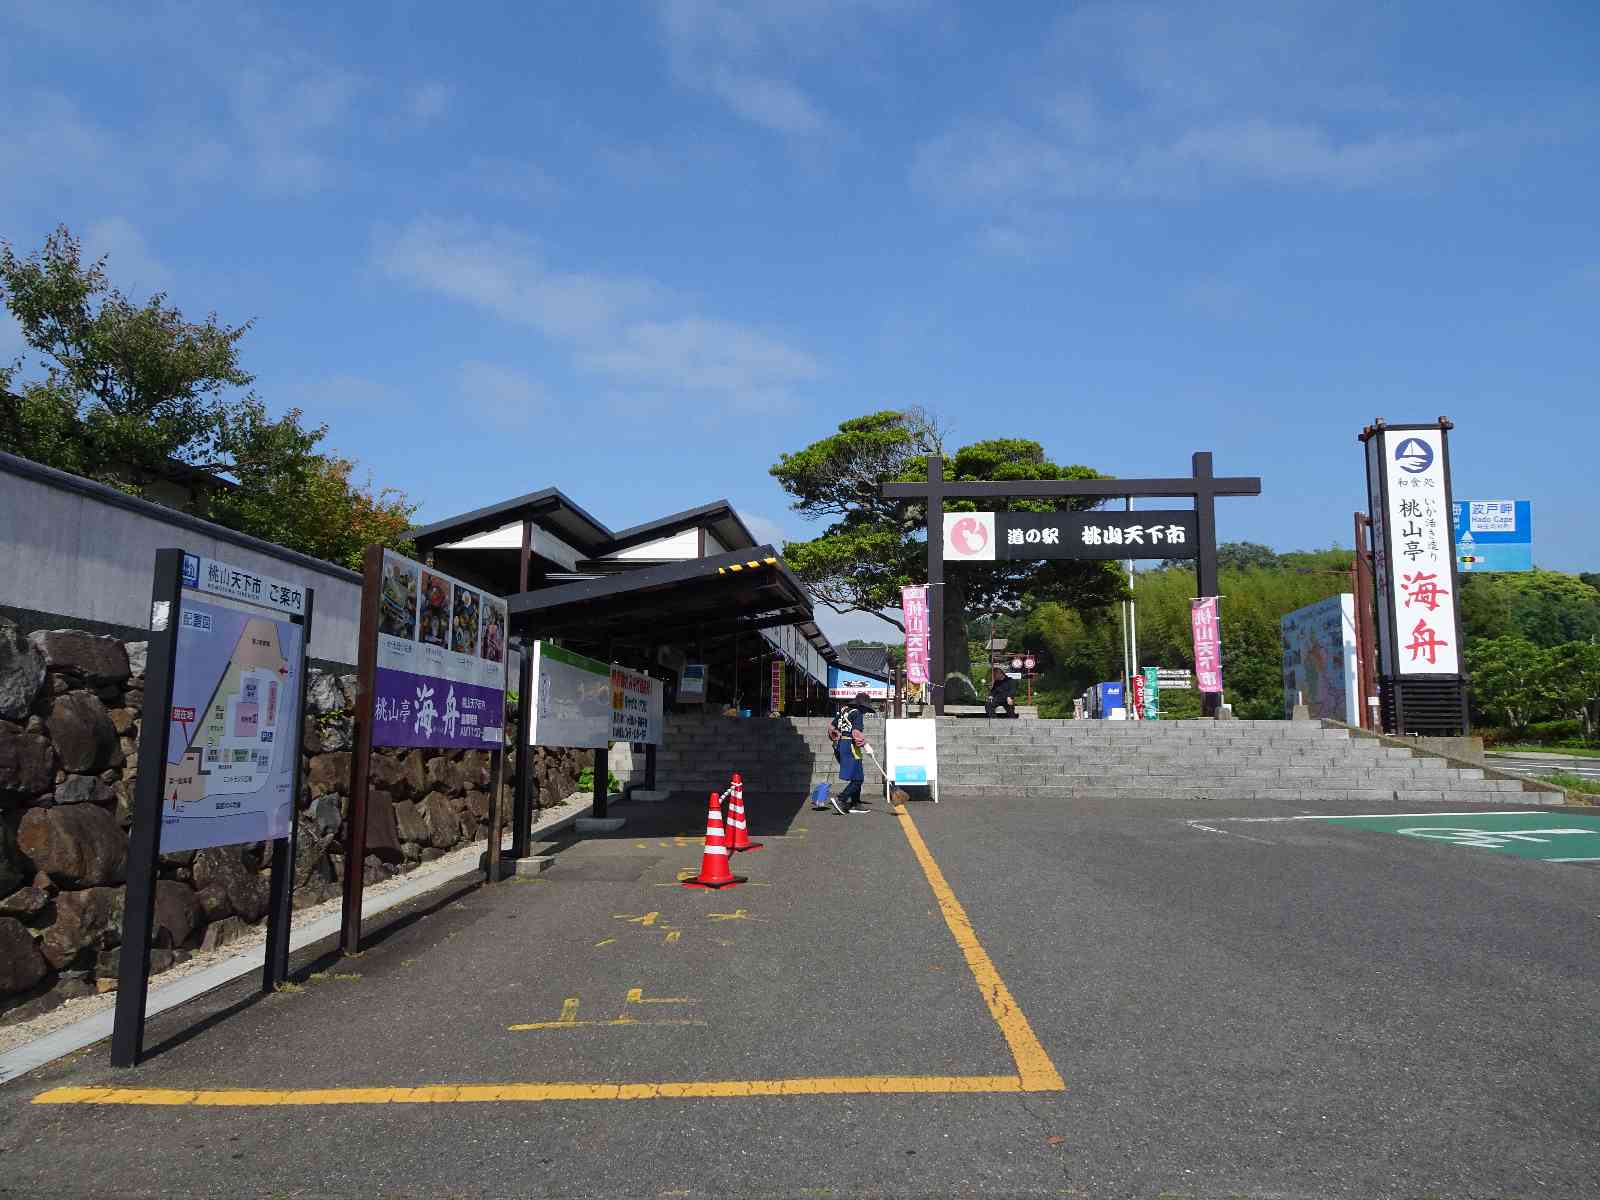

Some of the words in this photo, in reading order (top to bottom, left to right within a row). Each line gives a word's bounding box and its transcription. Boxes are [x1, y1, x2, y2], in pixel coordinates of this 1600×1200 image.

[1398, 477, 1435, 488] 和食処
[1007, 527, 1060, 545] 道の駅
[1080, 524, 1186, 545] 桃山天下市
[1399, 498, 1424, 562] 桃山亭
[208, 563, 262, 596] 桃山天下市
[269, 583, 302, 609] ご案内
[1401, 570, 1449, 665] 海舟
[375, 696, 411, 723] 桃山亭
[414, 683, 460, 739] 海舟
